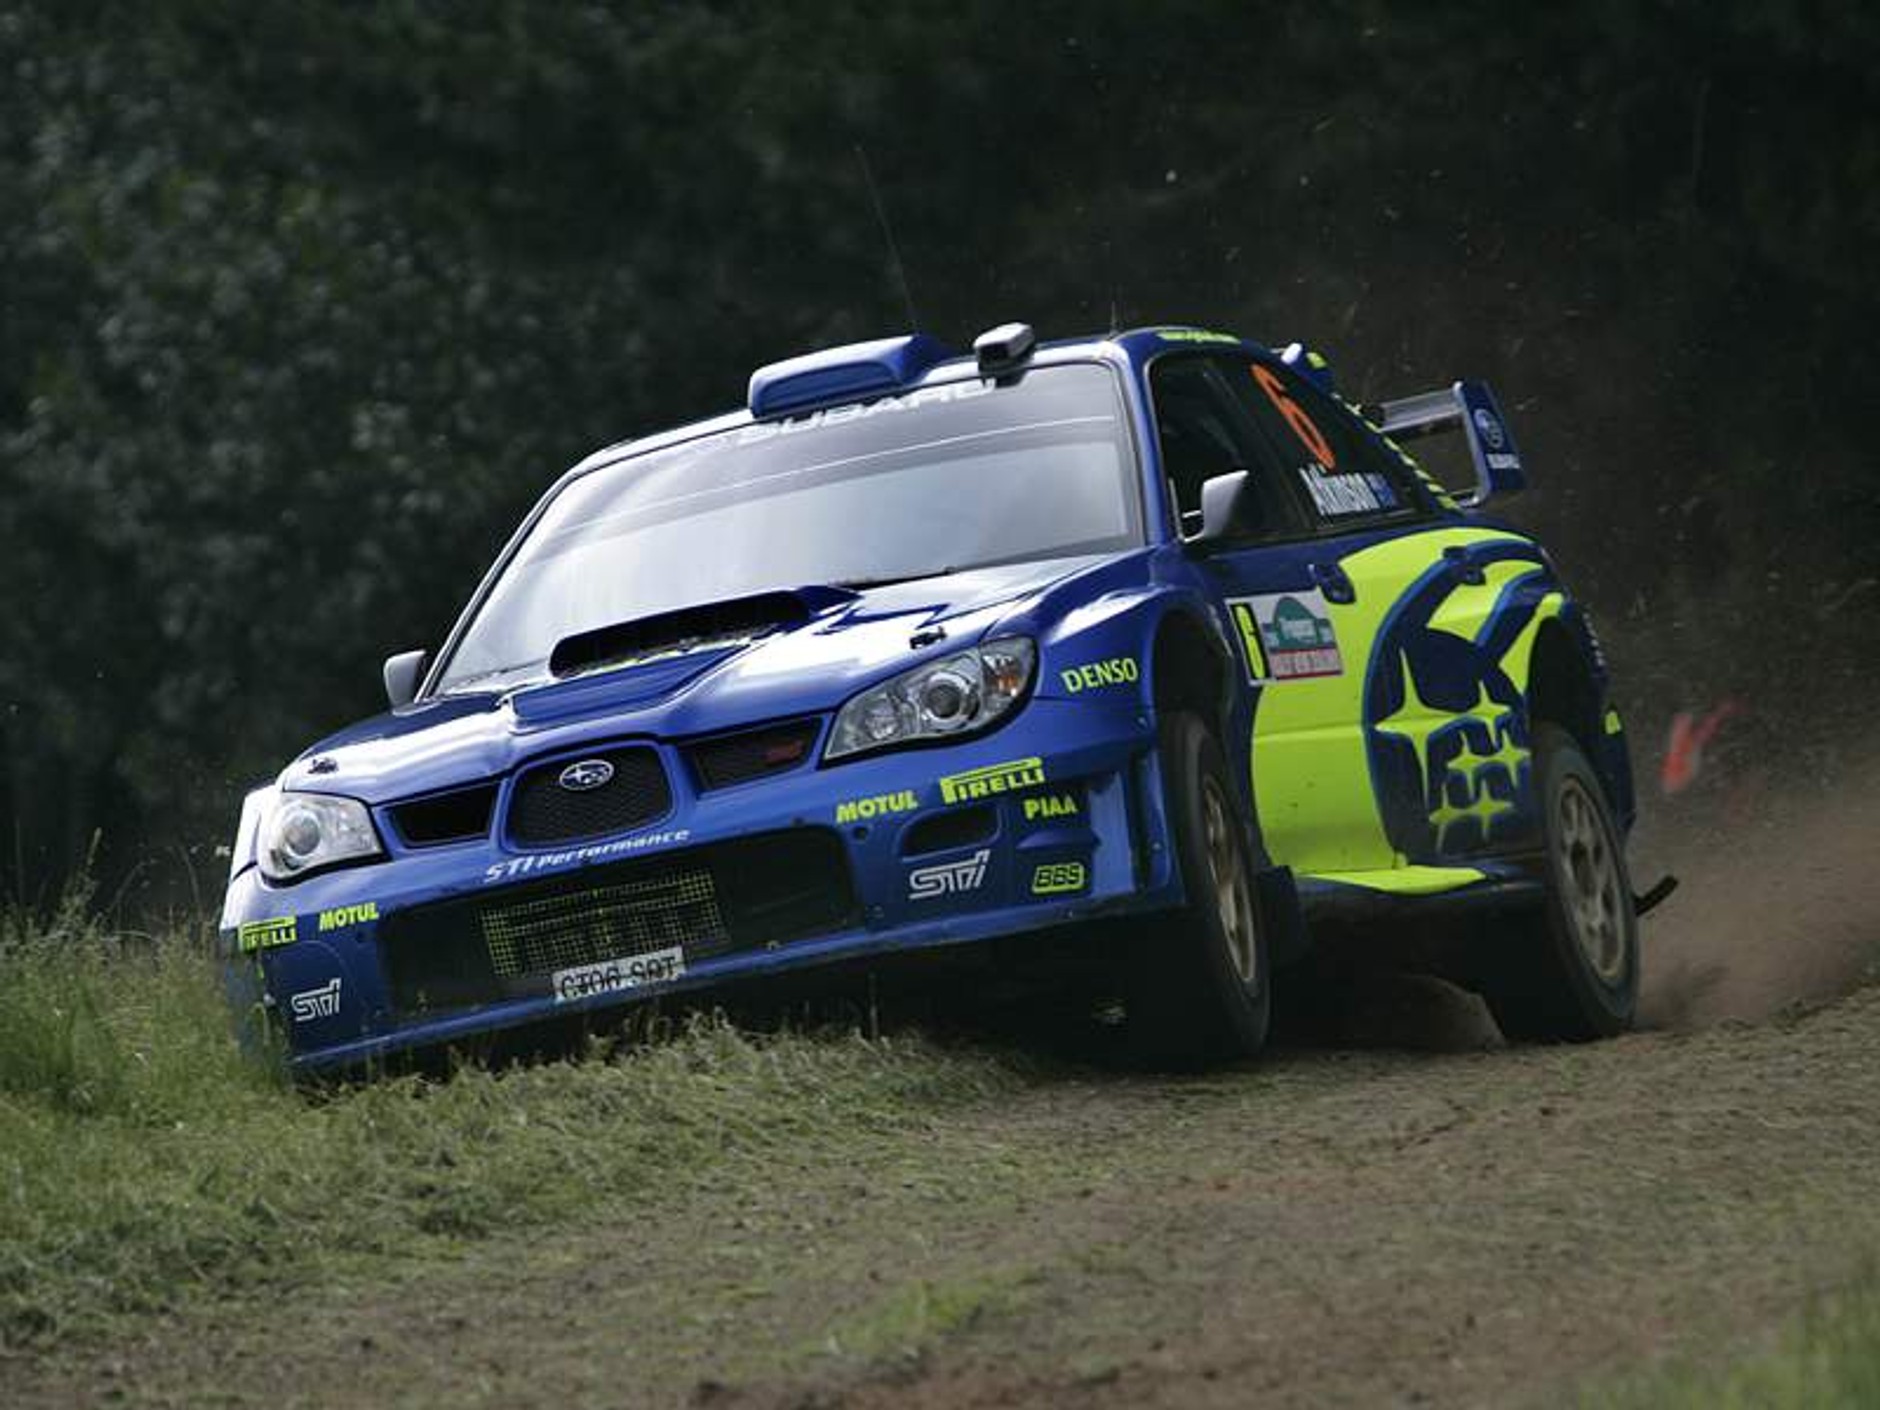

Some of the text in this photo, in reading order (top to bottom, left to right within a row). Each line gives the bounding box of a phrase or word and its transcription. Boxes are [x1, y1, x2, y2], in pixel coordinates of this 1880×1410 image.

[1251, 364, 1336, 470] 6
[1061, 657, 1138, 693] DENSO
[940, 757, 1045, 804] PIRELLI
[836, 790, 918, 824] MOTUL
[1024, 794, 1078, 819] PIAA
[1031, 863, 1085, 894] BBS
[319, 902, 379, 932] MOTUL
